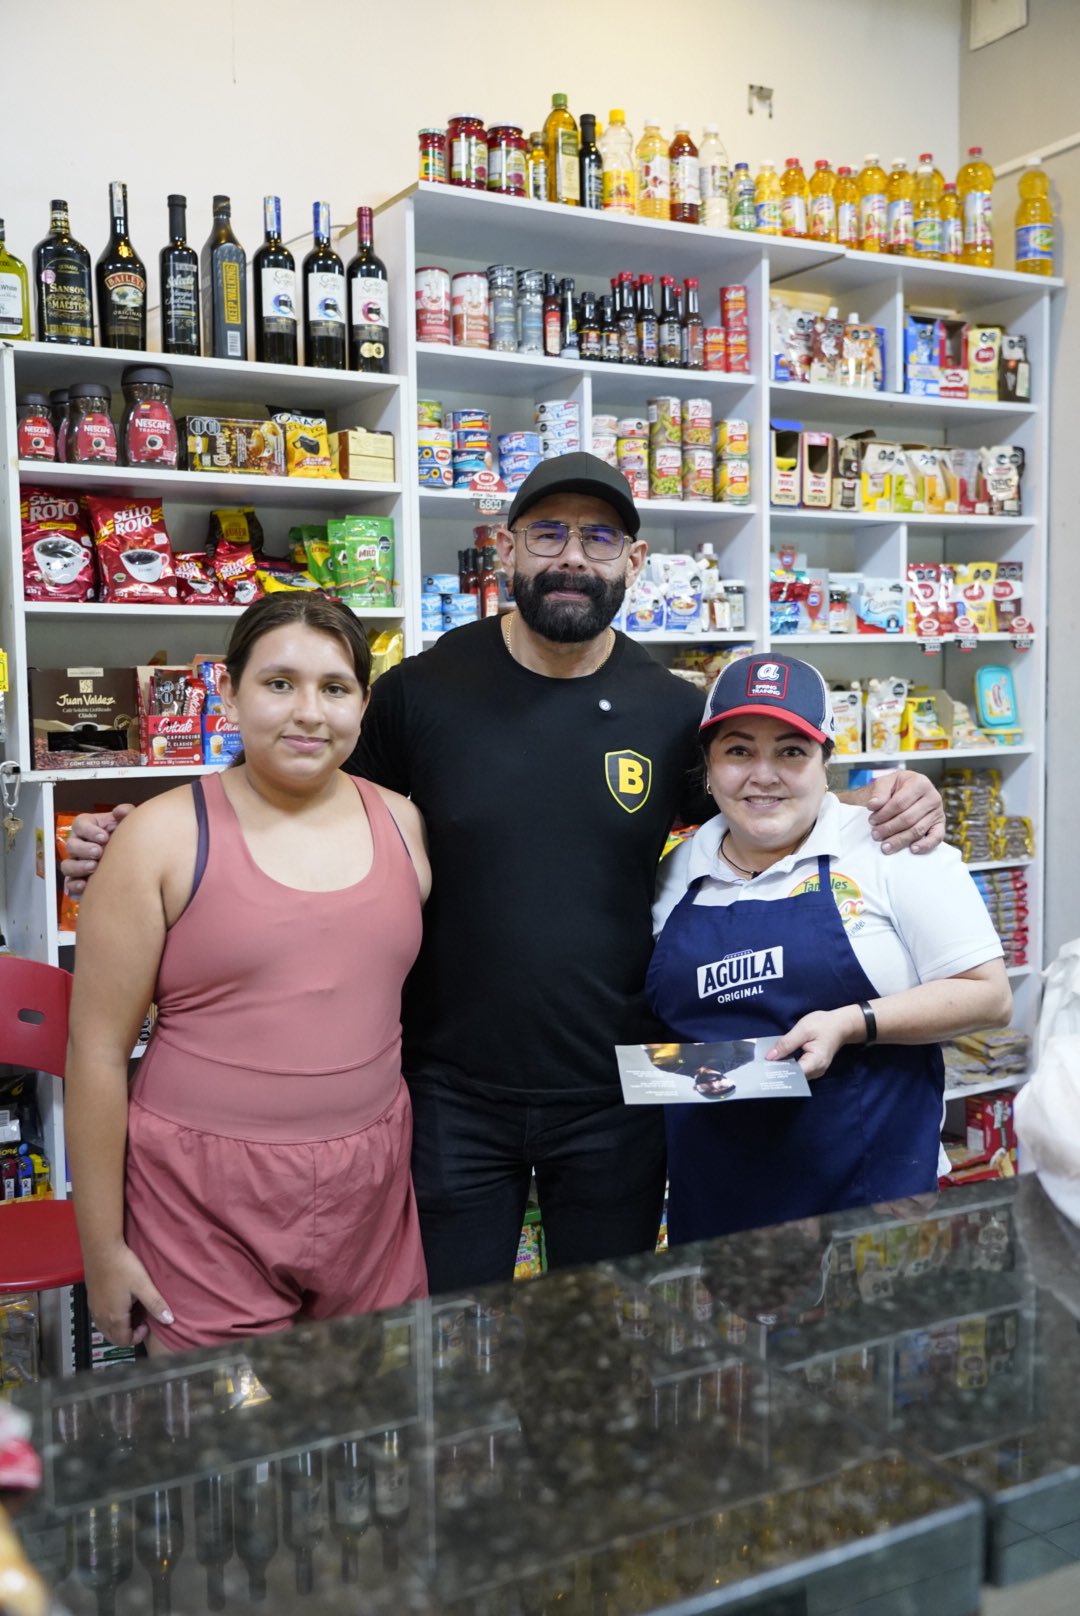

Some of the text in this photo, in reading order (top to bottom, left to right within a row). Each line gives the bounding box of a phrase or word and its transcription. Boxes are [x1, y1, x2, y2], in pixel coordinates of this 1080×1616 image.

[108, 273, 144, 290] BAILEYS
[29, 501, 79, 523] ROJO
[114, 505, 151, 524] SELLO
[115, 516, 153, 535] ROJO
[220, 560, 245, 575] SELLO
[222, 566, 247, 579] ROJO
[56, 693, 116, 707] Juan Valdez
[752, 688, 781, 696] TRAINING
[618, 757, 645, 795] B
[703, 951, 777, 995] AGUILA
[717, 984, 764, 1004] ORIGINAL
